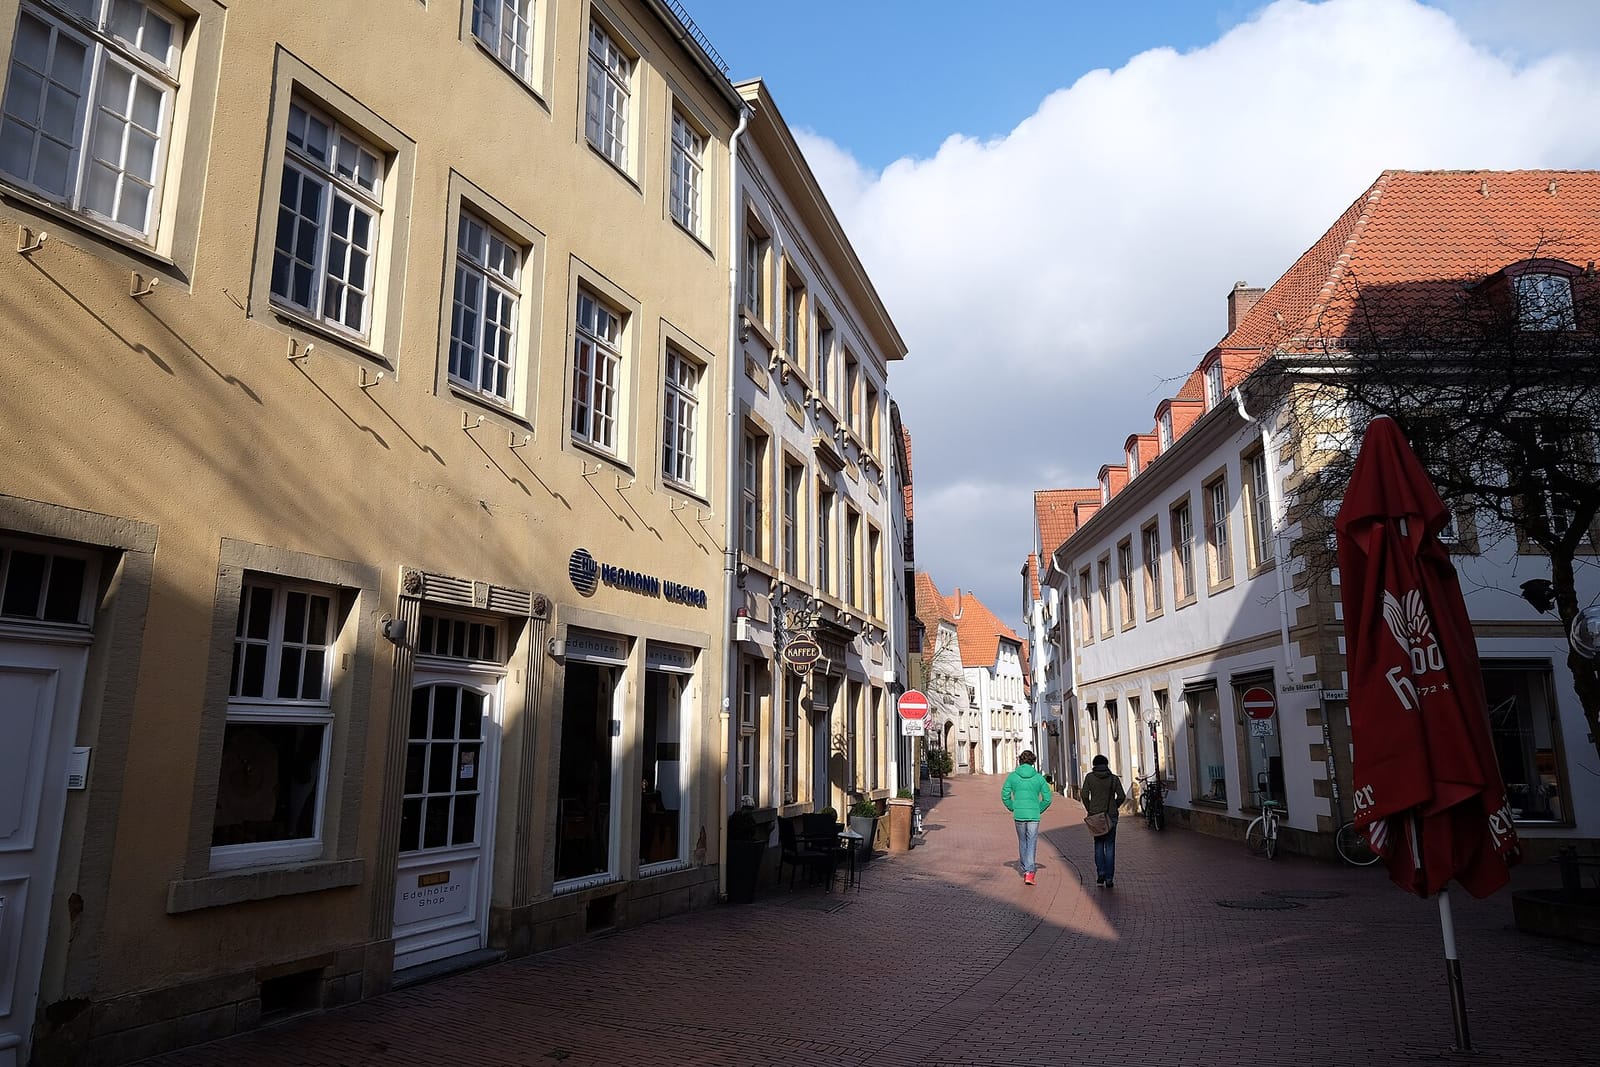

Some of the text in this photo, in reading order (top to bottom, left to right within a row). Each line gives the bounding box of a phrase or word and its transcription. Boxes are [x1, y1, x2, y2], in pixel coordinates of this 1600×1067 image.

[601, 563, 706, 605] HERMANN WISCHER
[787, 647, 817, 657] KAFFEE
[418, 896, 445, 907] Shop
